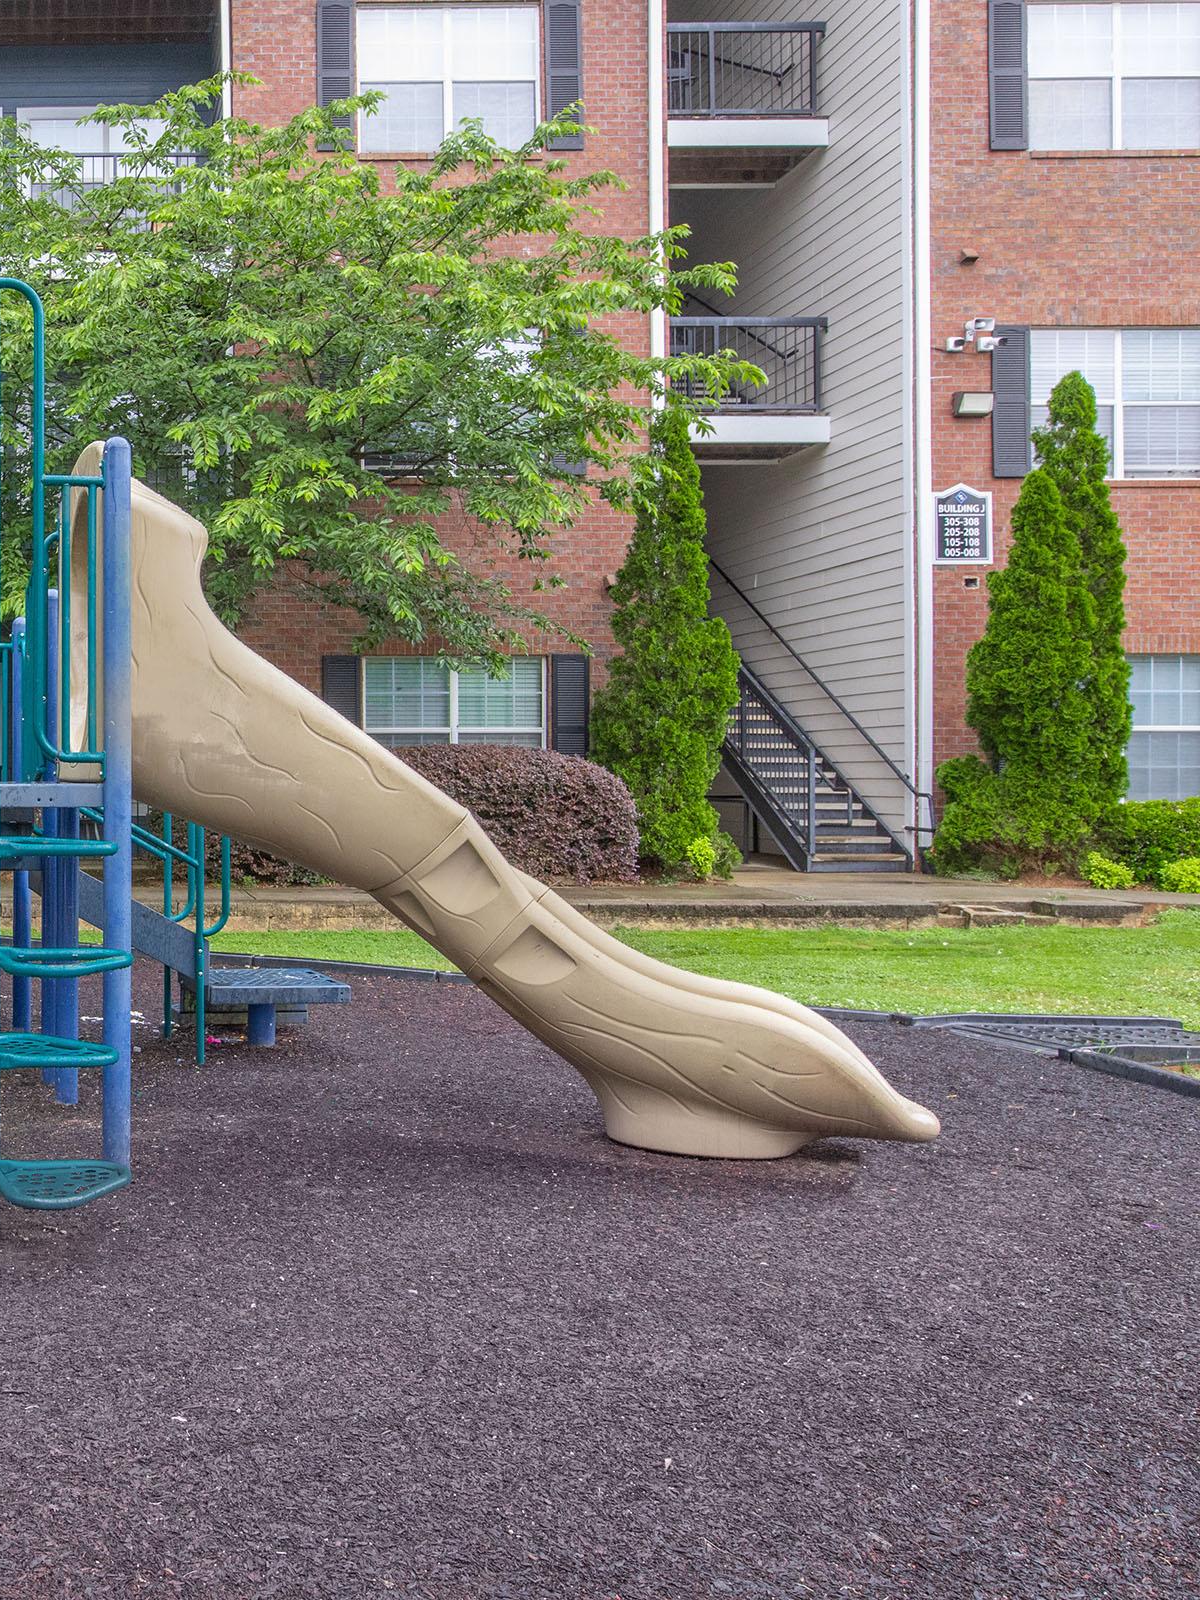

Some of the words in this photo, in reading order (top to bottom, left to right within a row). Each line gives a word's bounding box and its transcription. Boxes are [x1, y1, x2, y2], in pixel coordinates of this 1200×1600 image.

[938, 504, 979, 513] BUILDING
[981, 504, 985, 513] J
[944, 518, 980, 526] 305-308
[944, 528, 980, 536] 205-208
[944, 538, 980, 546] 105-108
[944, 548, 980, 556] 005-008
